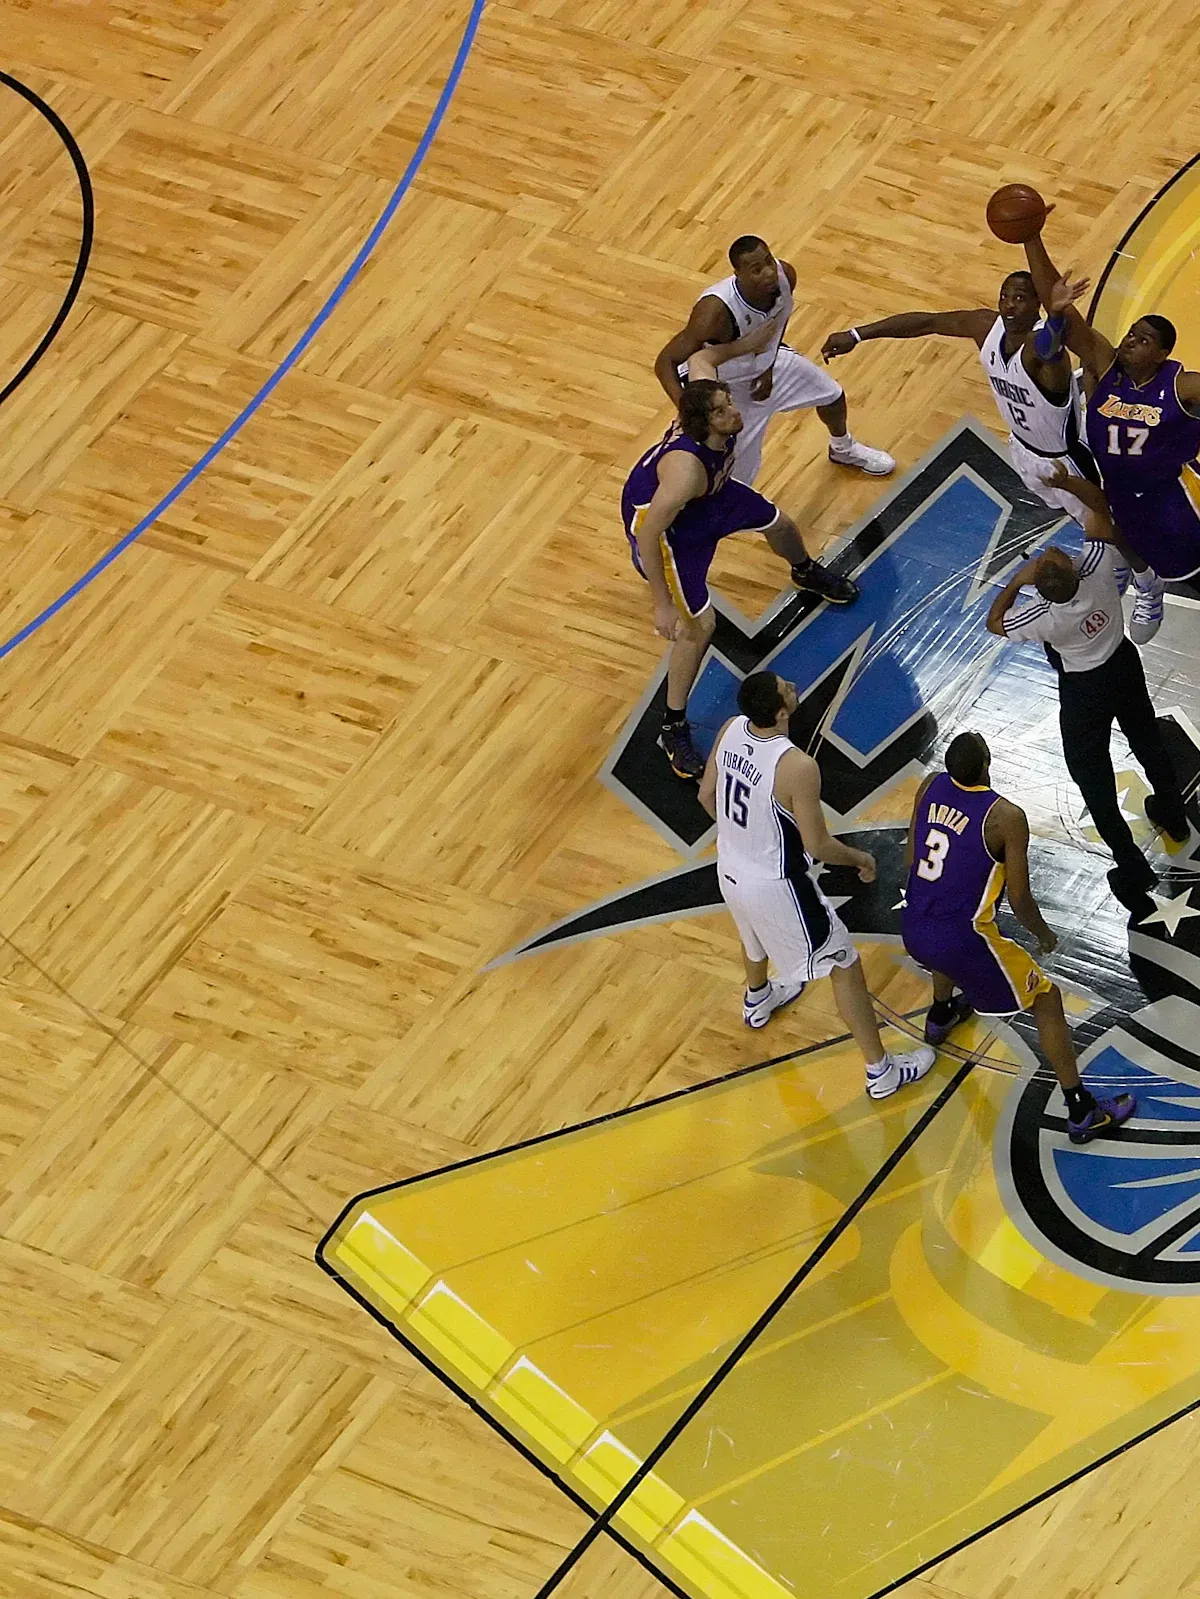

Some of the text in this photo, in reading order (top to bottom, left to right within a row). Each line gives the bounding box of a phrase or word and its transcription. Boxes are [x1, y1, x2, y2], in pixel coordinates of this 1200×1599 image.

[1006, 402, 1032, 431] 12
[1097, 394, 1163, 427] LAKERS
[1107, 424, 1150, 456] 17
[1083, 612, 1106, 636] 43
[722, 750, 763, 787] TURKOGLU
[724, 771, 752, 830] 15
[927, 803, 970, 836] ARIZA
[917, 828, 950, 882] 3
